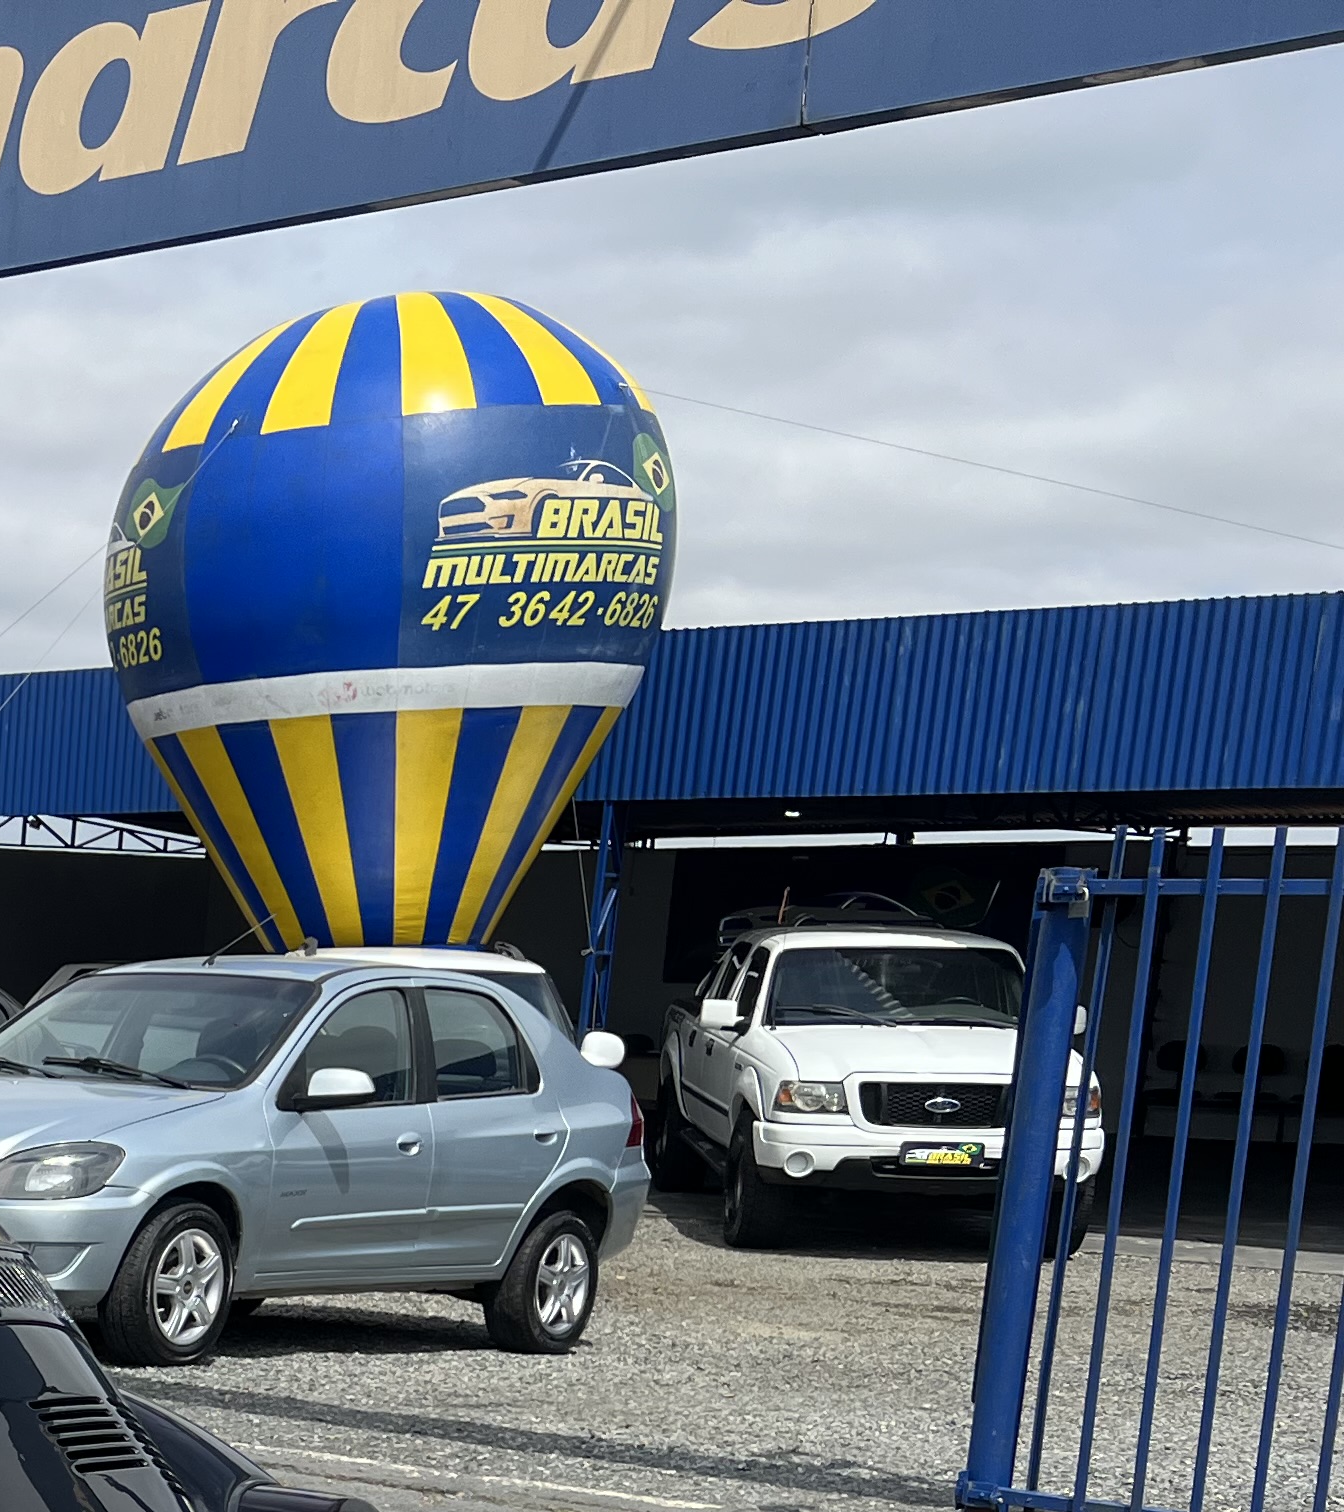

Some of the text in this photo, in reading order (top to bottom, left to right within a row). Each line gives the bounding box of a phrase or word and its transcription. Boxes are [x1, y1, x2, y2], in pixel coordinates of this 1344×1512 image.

[536, 498, 664, 543] BRASIL
[422, 552, 661, 589] MULTIMARCAS
[421, 593, 481, 631] 47
